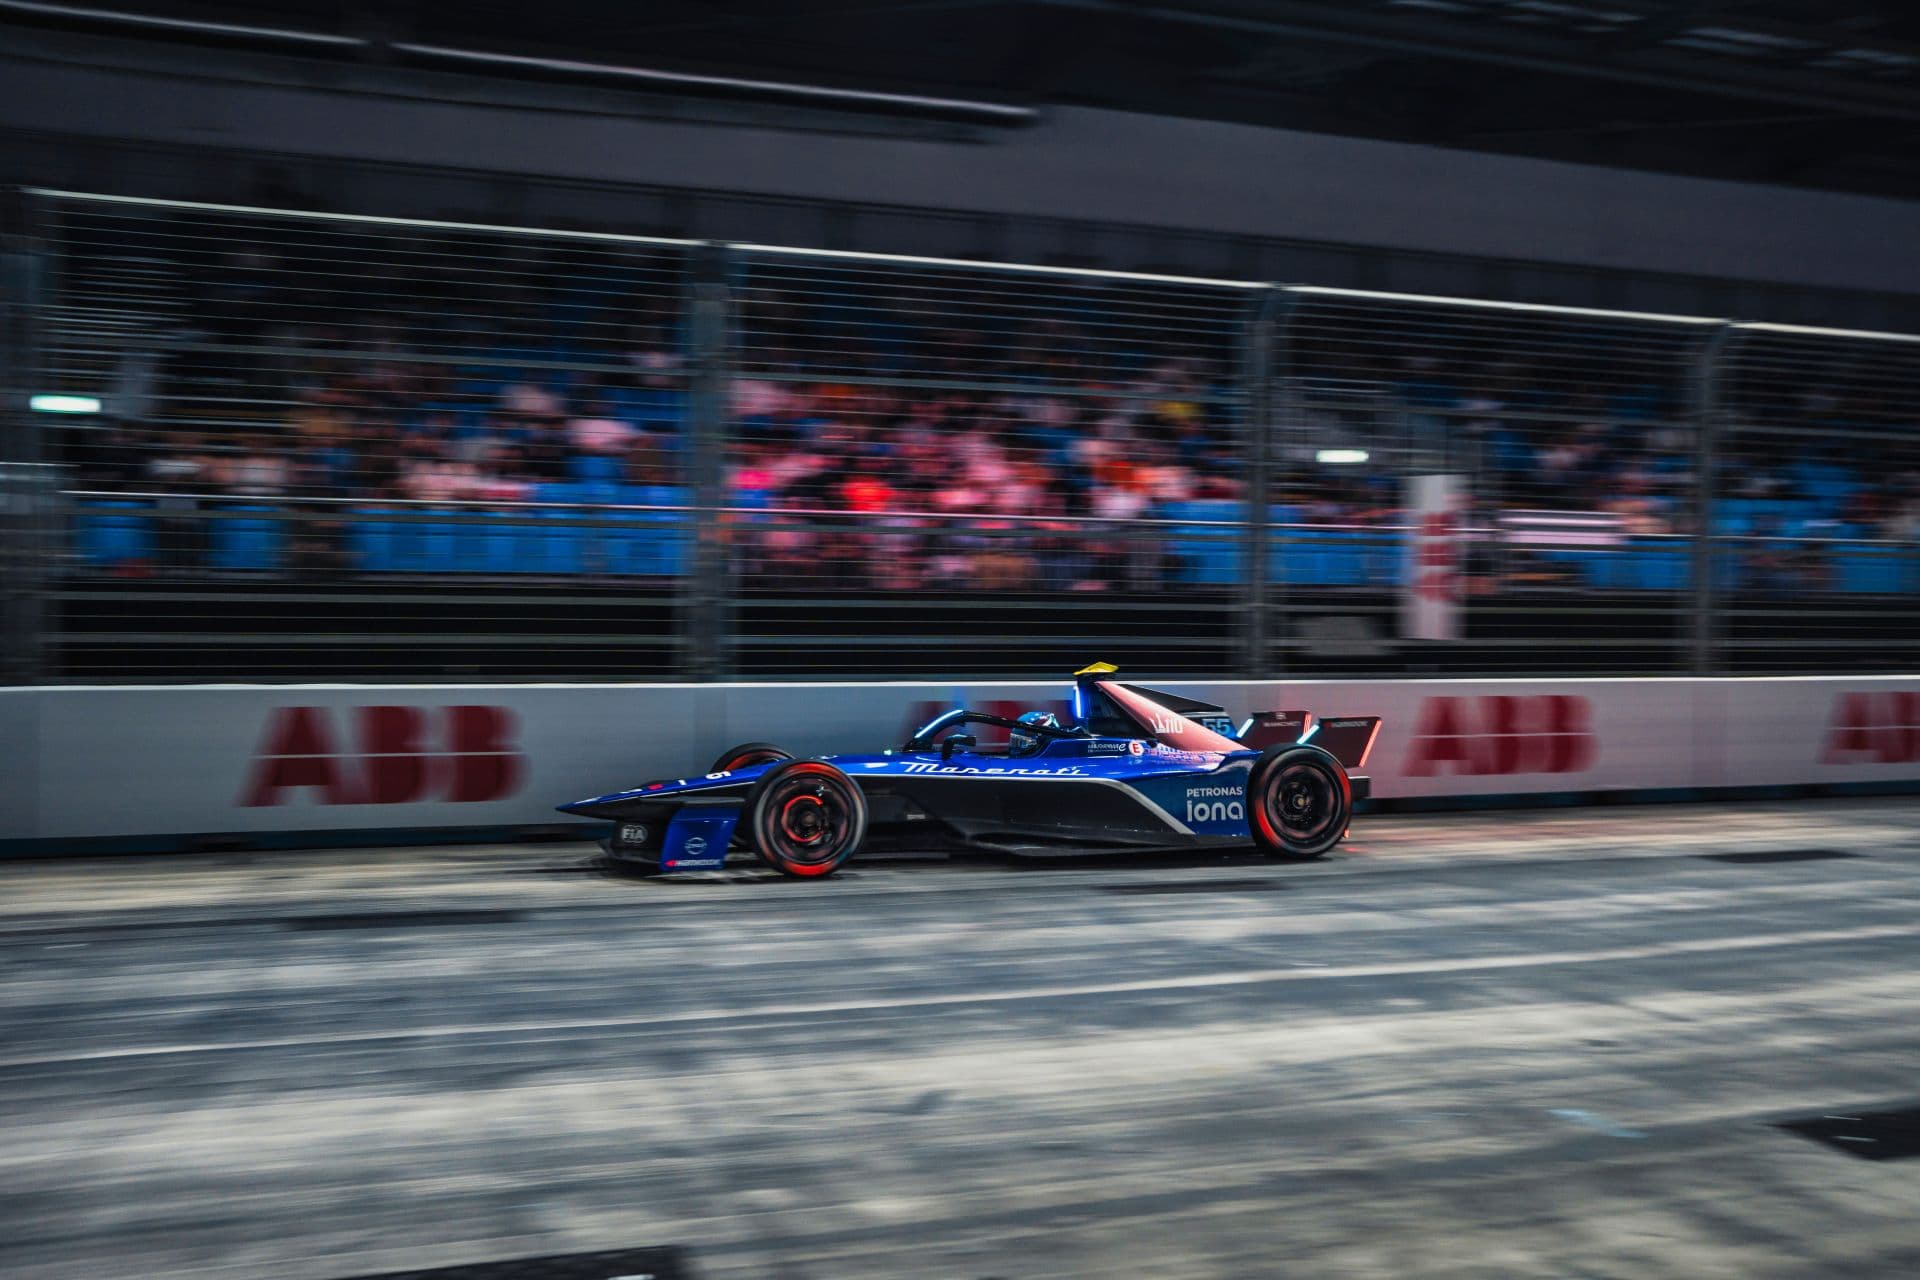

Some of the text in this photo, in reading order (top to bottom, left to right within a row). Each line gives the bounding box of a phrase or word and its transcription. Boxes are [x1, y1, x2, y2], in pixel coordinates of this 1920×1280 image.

[1203, 719, 1232, 735] 55
[1399, 695, 1597, 777] ABB
[236, 705, 530, 807] ABB
[900, 761, 1089, 776] Maserati
[1186, 786, 1243, 798] PETRONAS
[1186, 800, 1244, 823] iona
[622, 828, 647, 840] FIA
